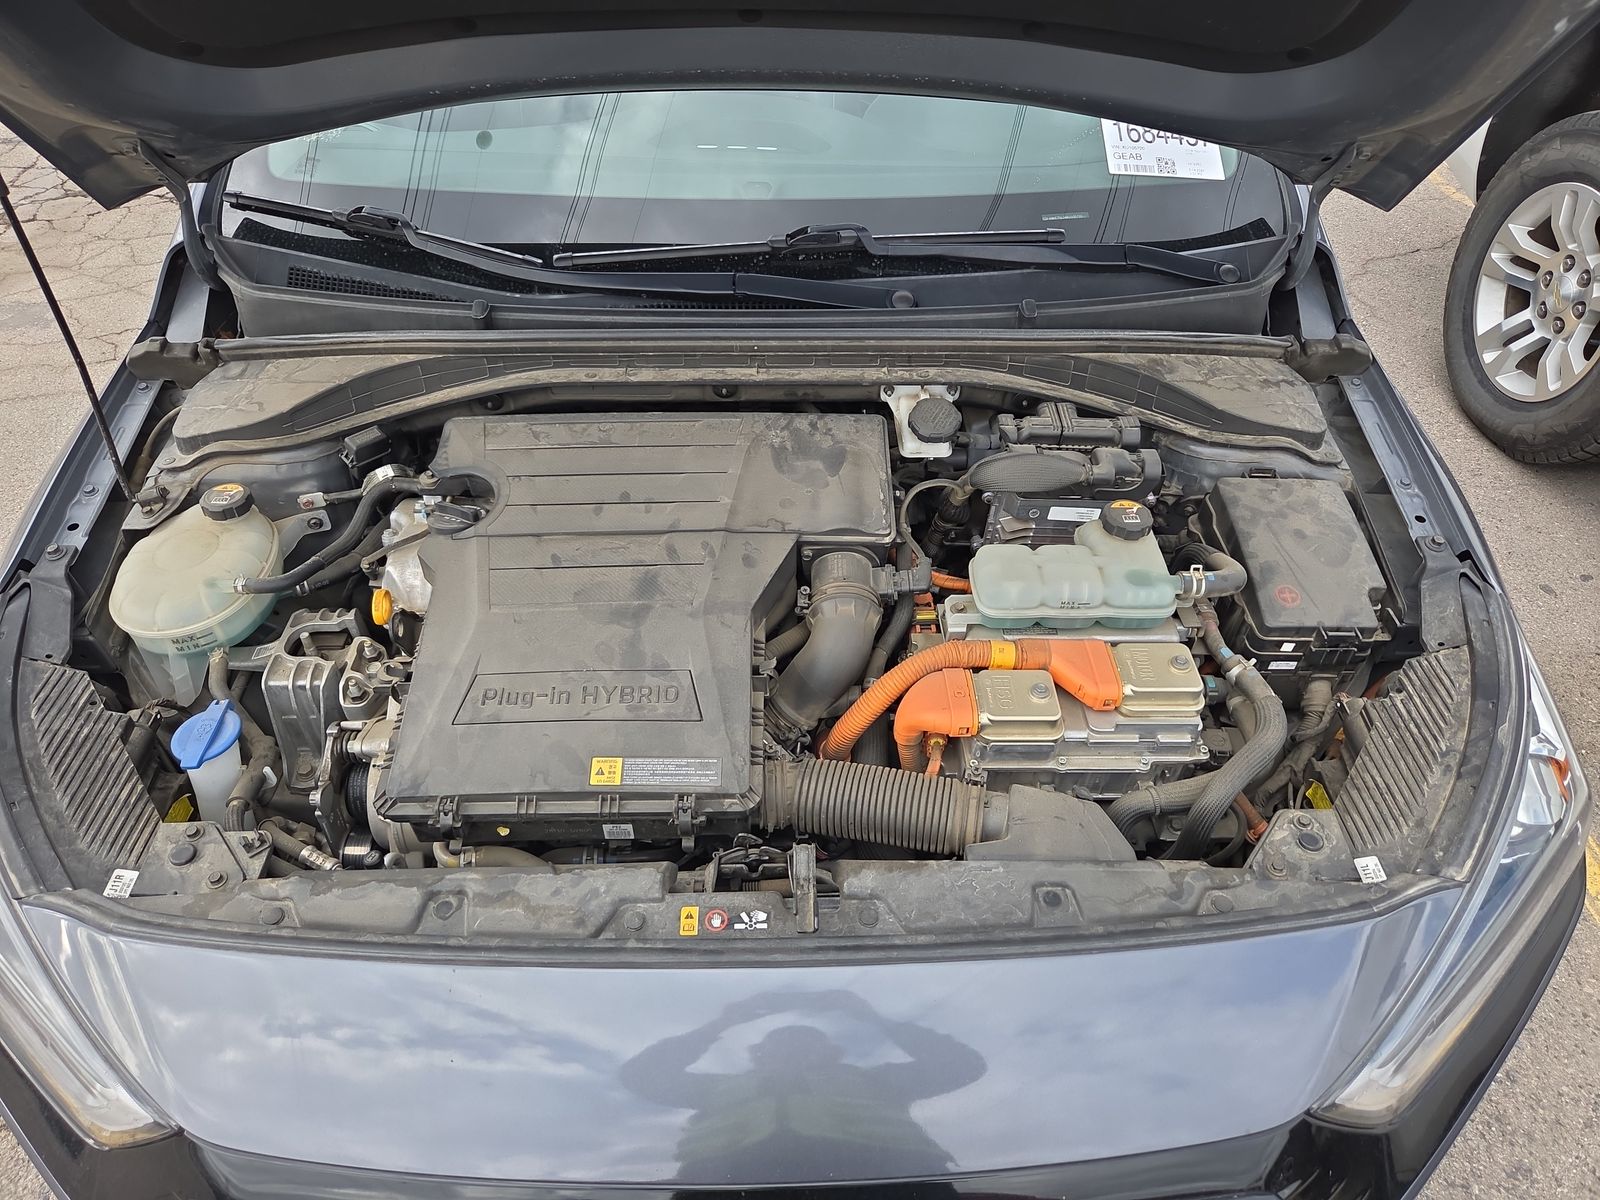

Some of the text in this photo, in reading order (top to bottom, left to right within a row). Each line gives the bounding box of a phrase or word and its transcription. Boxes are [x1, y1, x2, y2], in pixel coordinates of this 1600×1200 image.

[1113, 152, 1142, 161] GEAB
[171, 635, 195, 645] MAX
[175, 643, 200, 651] MIN
[480, 685, 680, 709] Plug-in HYBRID
[1360, 863, 1375, 880] J11L
[109, 874, 125, 893] J11R
